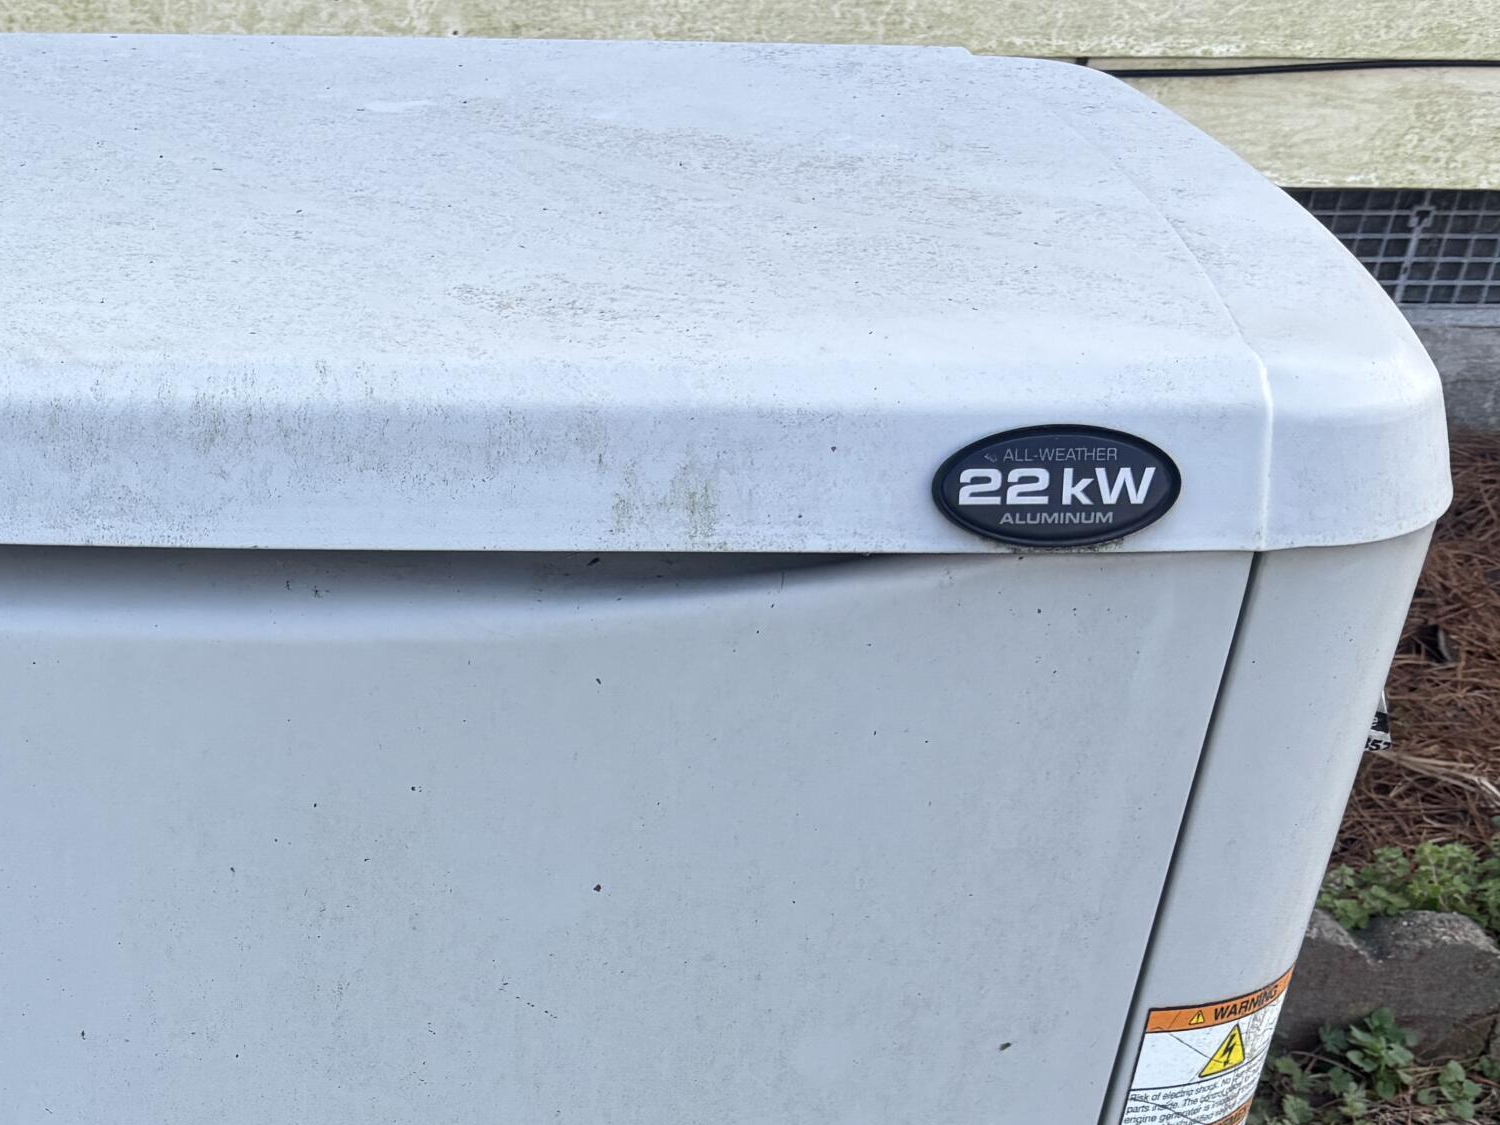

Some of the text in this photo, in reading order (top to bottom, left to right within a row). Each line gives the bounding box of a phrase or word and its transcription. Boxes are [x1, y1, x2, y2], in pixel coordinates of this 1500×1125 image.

[1003, 448, 1118, 463] ALL-WEATHER
[958, 466, 1157, 505] 22 kW
[999, 511, 1114, 525] ALUMINUM
[1213, 984, 1280, 1022] WARNING
[1124, 1114, 1157, 1125] engine
